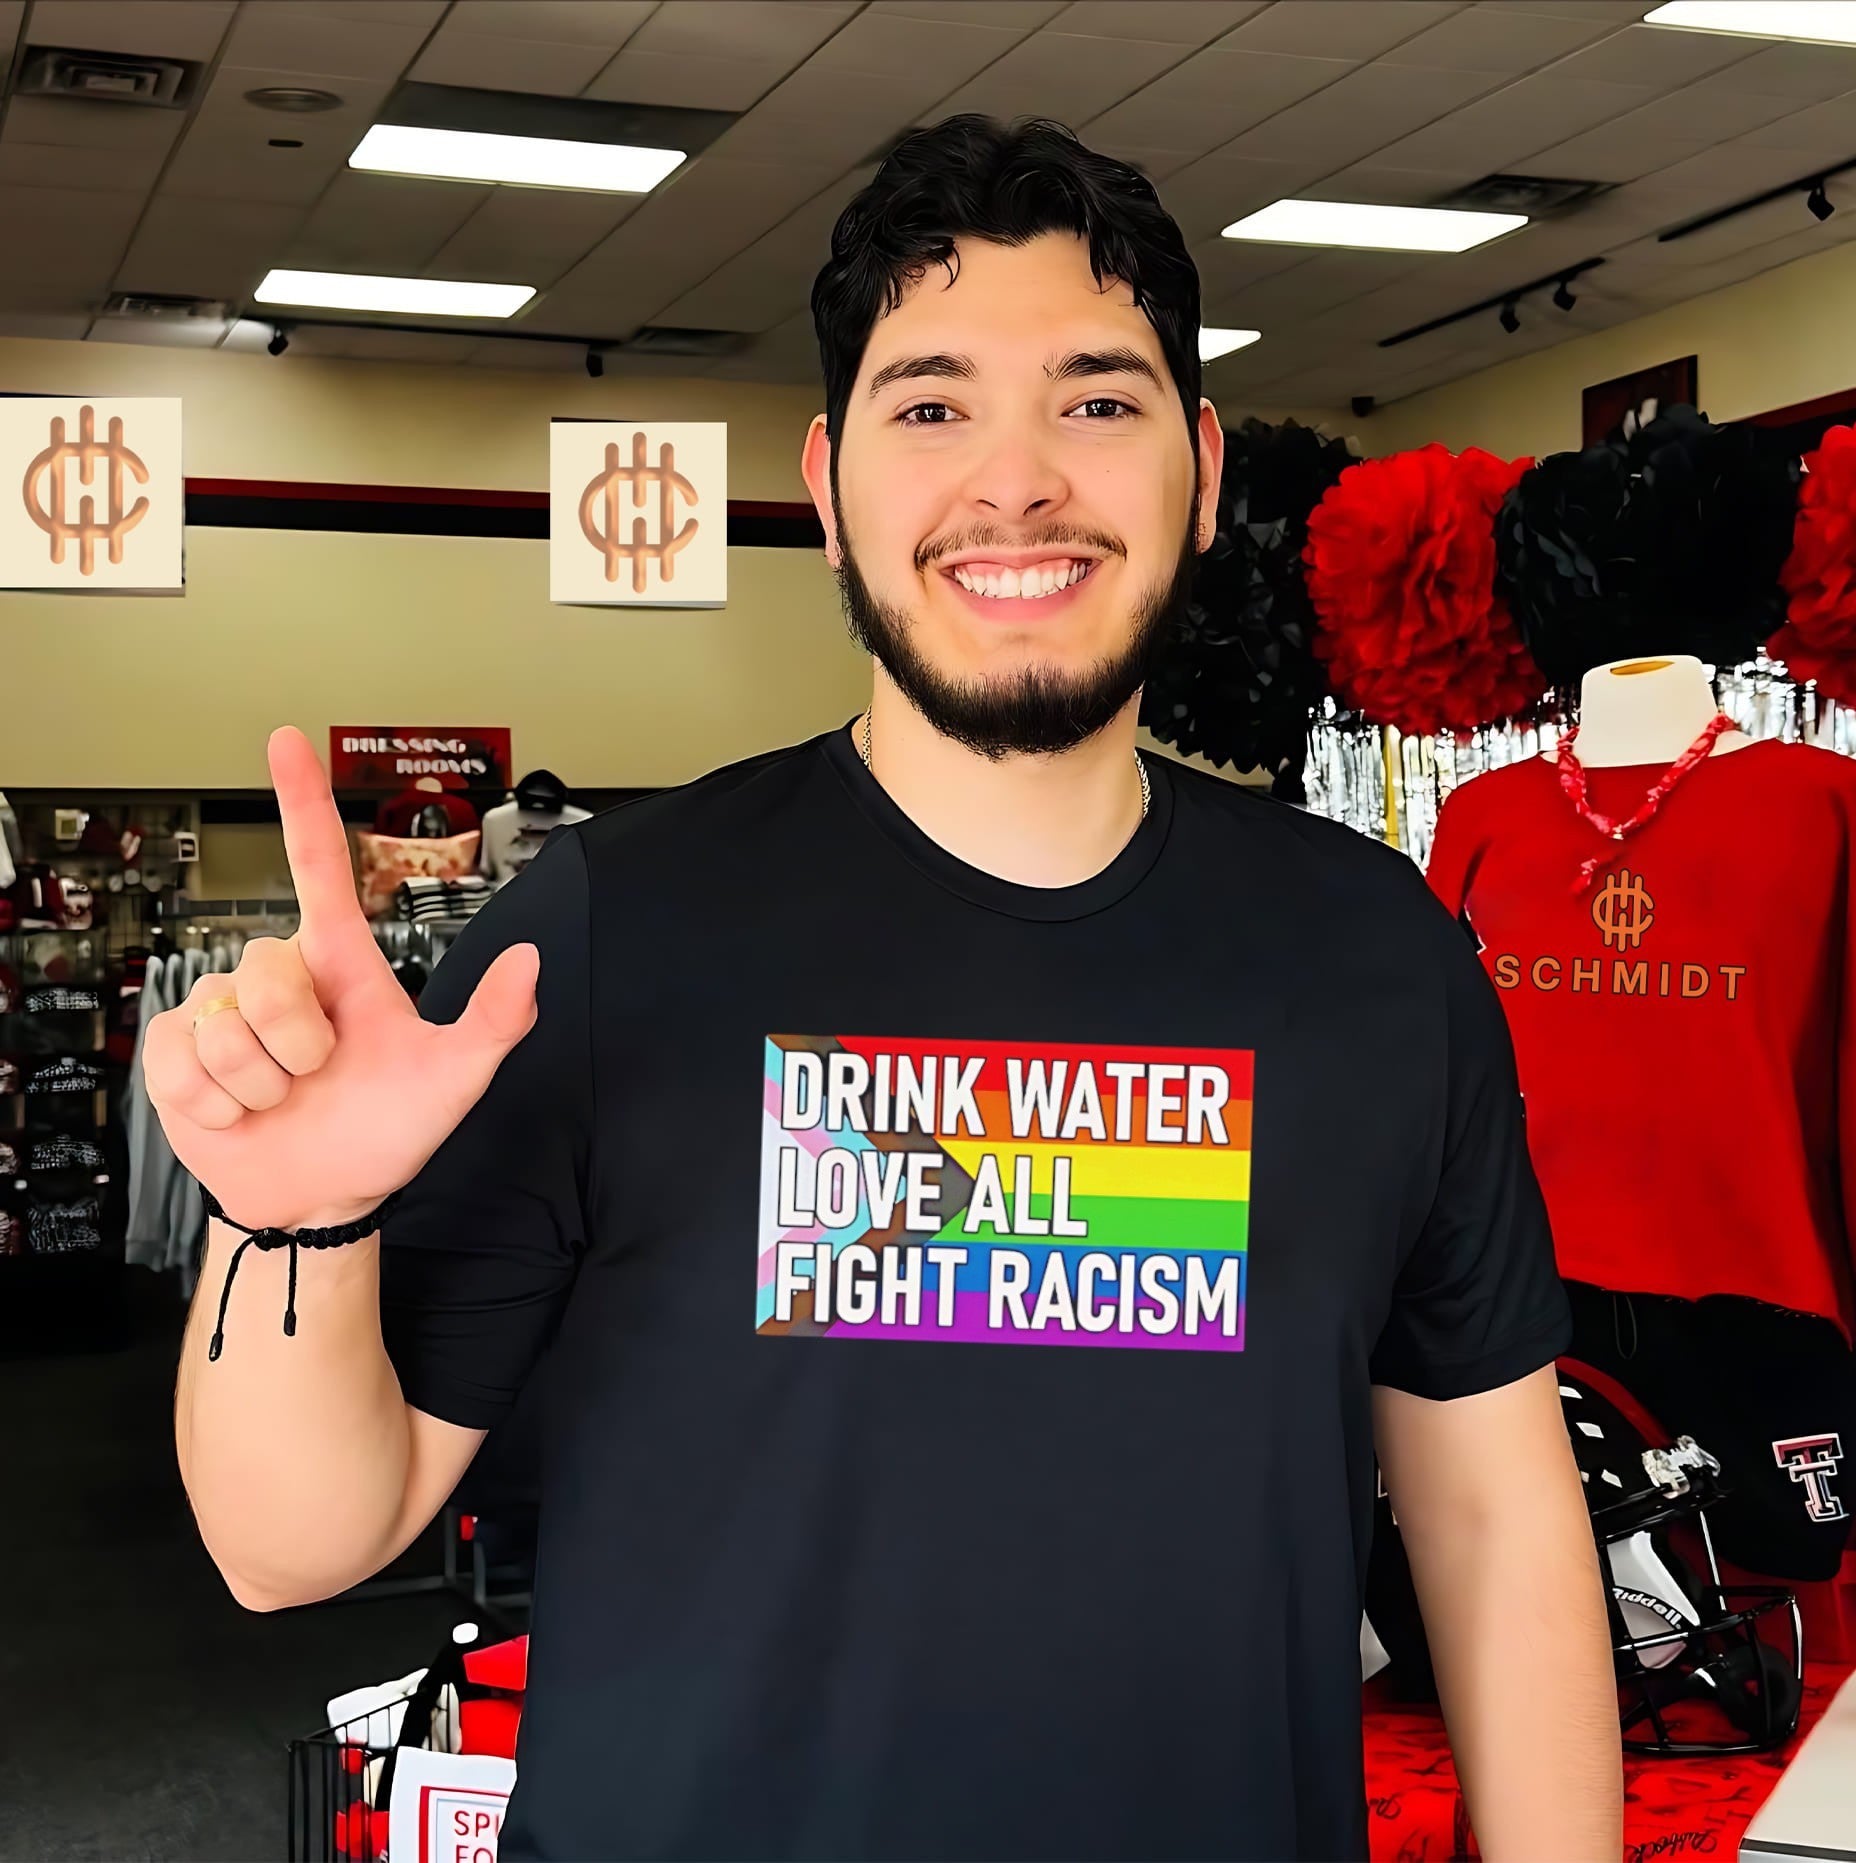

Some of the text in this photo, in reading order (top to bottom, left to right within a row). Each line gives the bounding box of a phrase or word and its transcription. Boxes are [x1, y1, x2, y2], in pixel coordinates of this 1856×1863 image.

[342, 737, 466, 754] DRESSING
[396, 758, 487, 775] ROOMS
[1494, 953, 1747, 1000] SCHMIDT
[780, 1049, 1231, 1145] DRINK WATER
[777, 1145, 1088, 1237] LOVE ALL
[774, 1241, 1241, 1338] FIGHT RACISM
